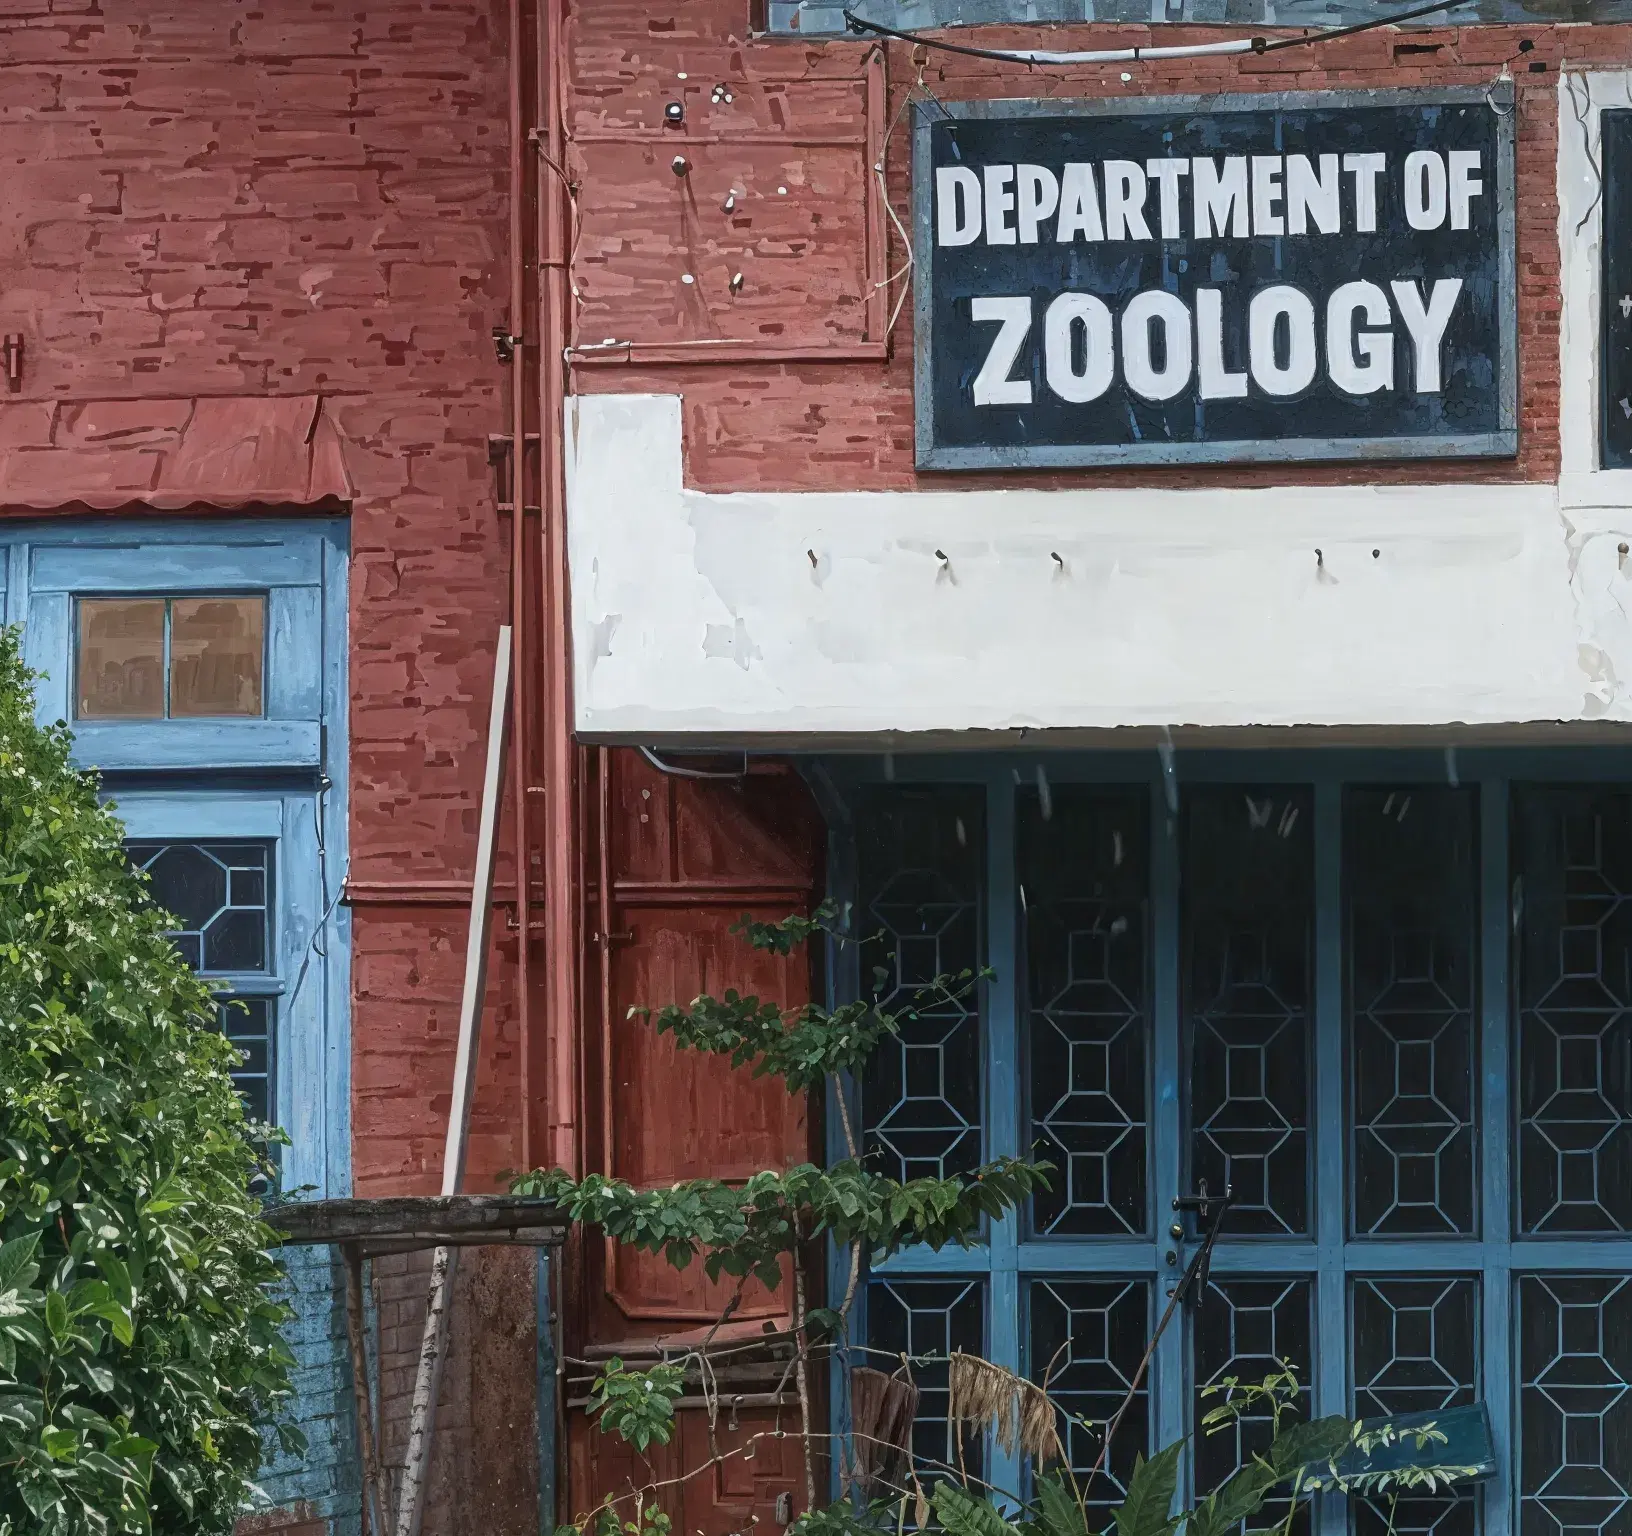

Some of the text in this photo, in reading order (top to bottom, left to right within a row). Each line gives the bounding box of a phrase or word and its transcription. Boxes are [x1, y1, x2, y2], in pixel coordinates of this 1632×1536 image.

[935, 149, 1484, 247] DEPARTMENT OF
[971, 278, 1463, 407] ZOOLOGY
